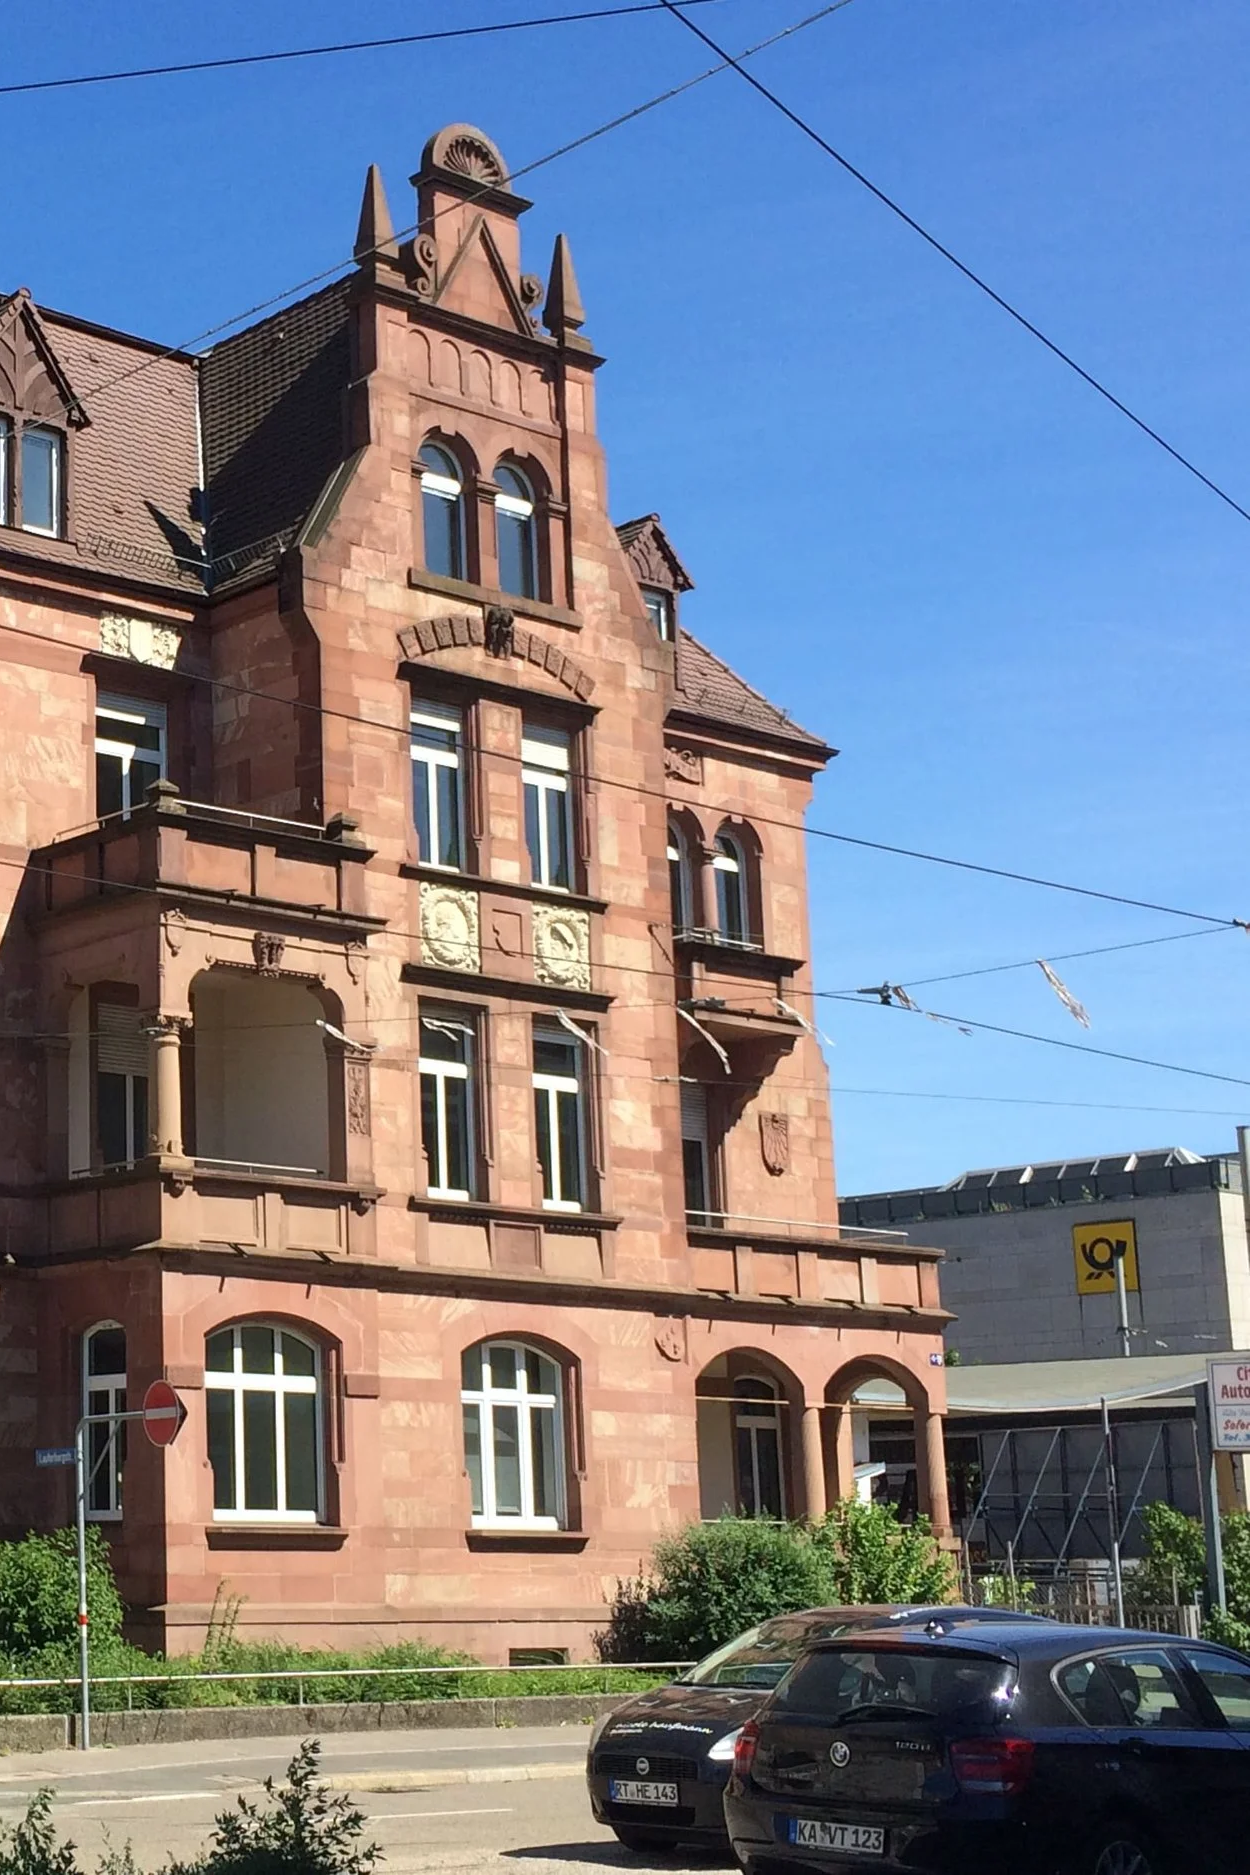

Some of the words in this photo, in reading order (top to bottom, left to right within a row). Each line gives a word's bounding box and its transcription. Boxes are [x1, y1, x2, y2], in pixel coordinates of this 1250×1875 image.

[614, 1782, 629, 1798] RT
[635, 1783, 652, 1799] HE
[653, 1784, 676, 1801] 143
[797, 1821, 817, 1843] KA
[828, 1825, 848, 1846] VT
[850, 1828, 883, 1850] 123
